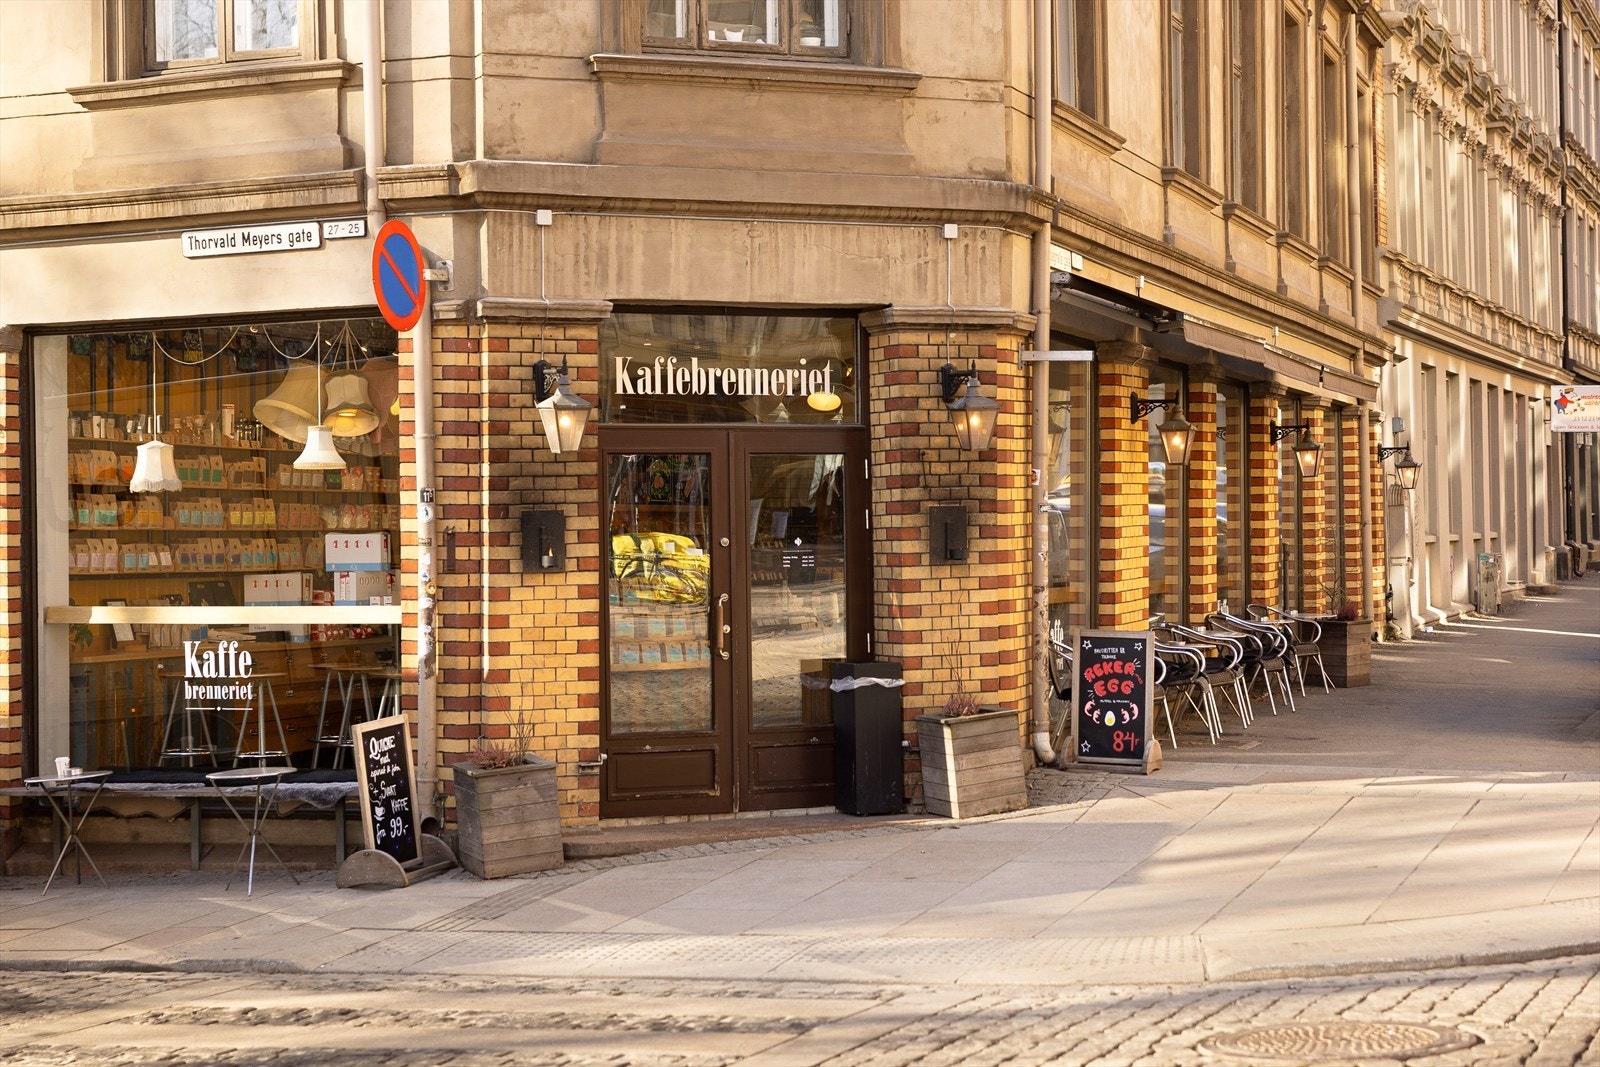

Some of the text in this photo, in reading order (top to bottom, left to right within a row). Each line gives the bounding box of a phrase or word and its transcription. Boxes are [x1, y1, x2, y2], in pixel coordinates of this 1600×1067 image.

[187, 228, 312, 251] Thorvald Meyers gate
[327, 225, 339, 235] 27
[348, 223, 360, 234] 25
[614, 355, 834, 397] Kaffebrenneriet
[183, 640, 253, 678] Kaffe
[1083, 660, 1136, 683] REKER
[184, 680, 253, 700] brenneriet
[1093, 678, 1135, 697] EGG
[391, 797, 409, 814] KAFFE
